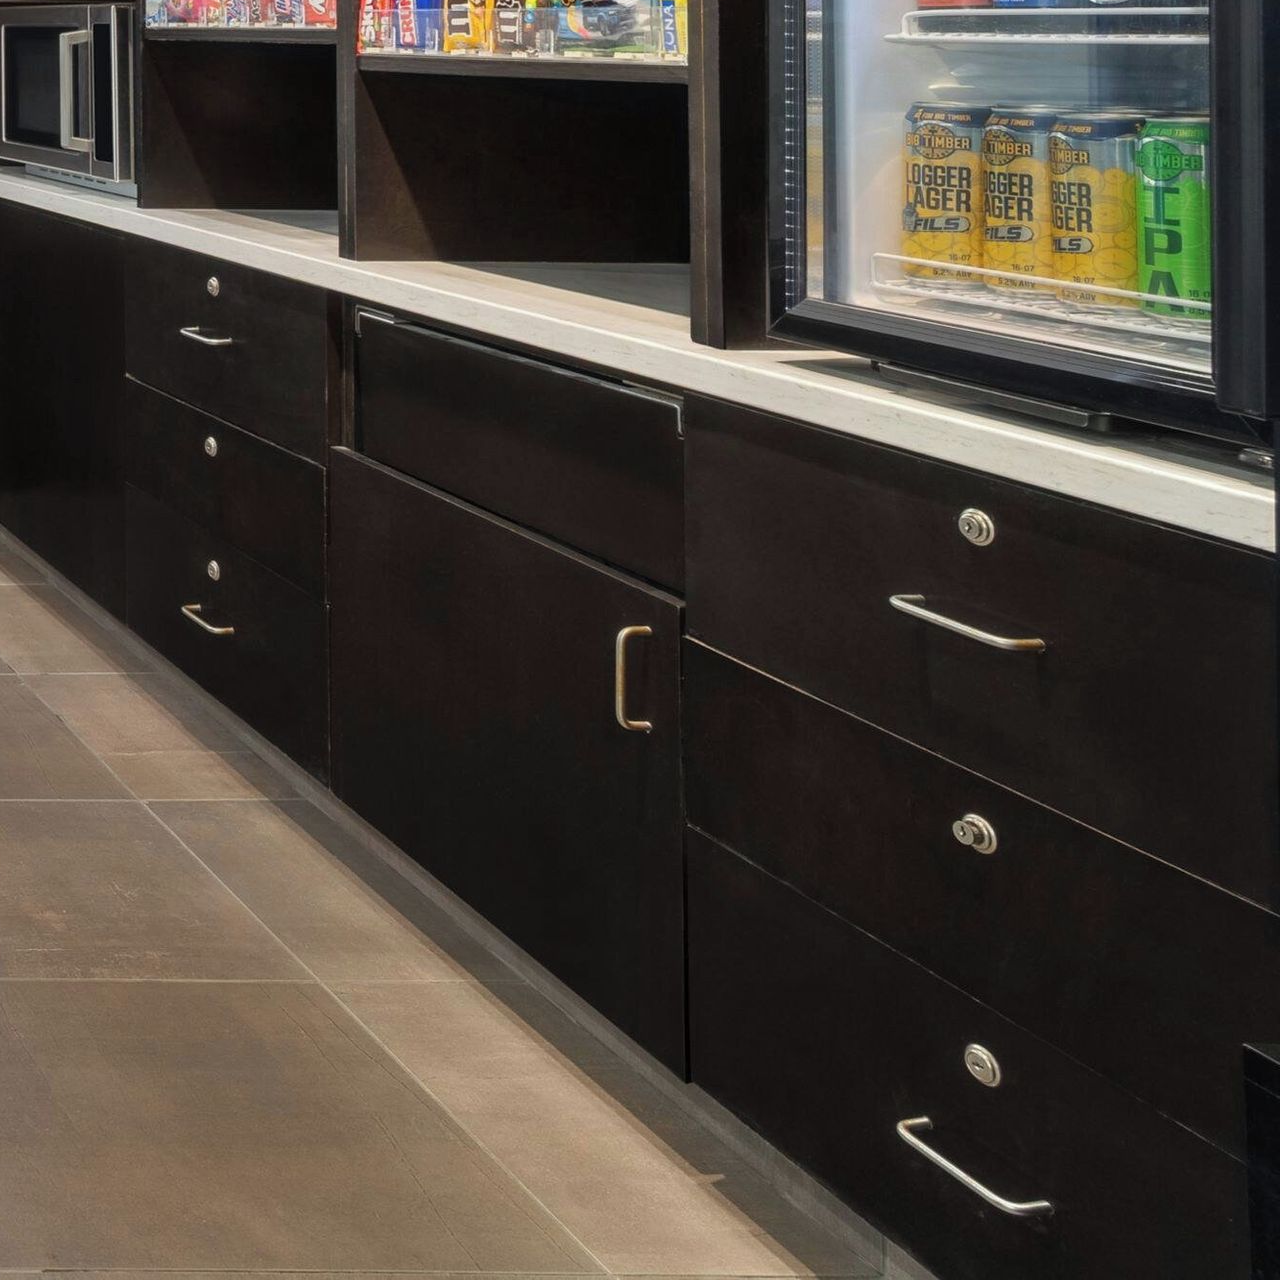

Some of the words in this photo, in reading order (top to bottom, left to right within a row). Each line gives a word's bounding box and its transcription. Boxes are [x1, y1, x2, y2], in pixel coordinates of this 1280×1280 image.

[924, 135, 971, 150] TIMBER
[989, 141, 1033, 157] TIMBER
[1149, 154, 1203, 170] TIMBER
[905, 161, 972, 190] LOGGER
[905, 183, 972, 213] LAGER
[1144, 185, 1185, 313] IPA
